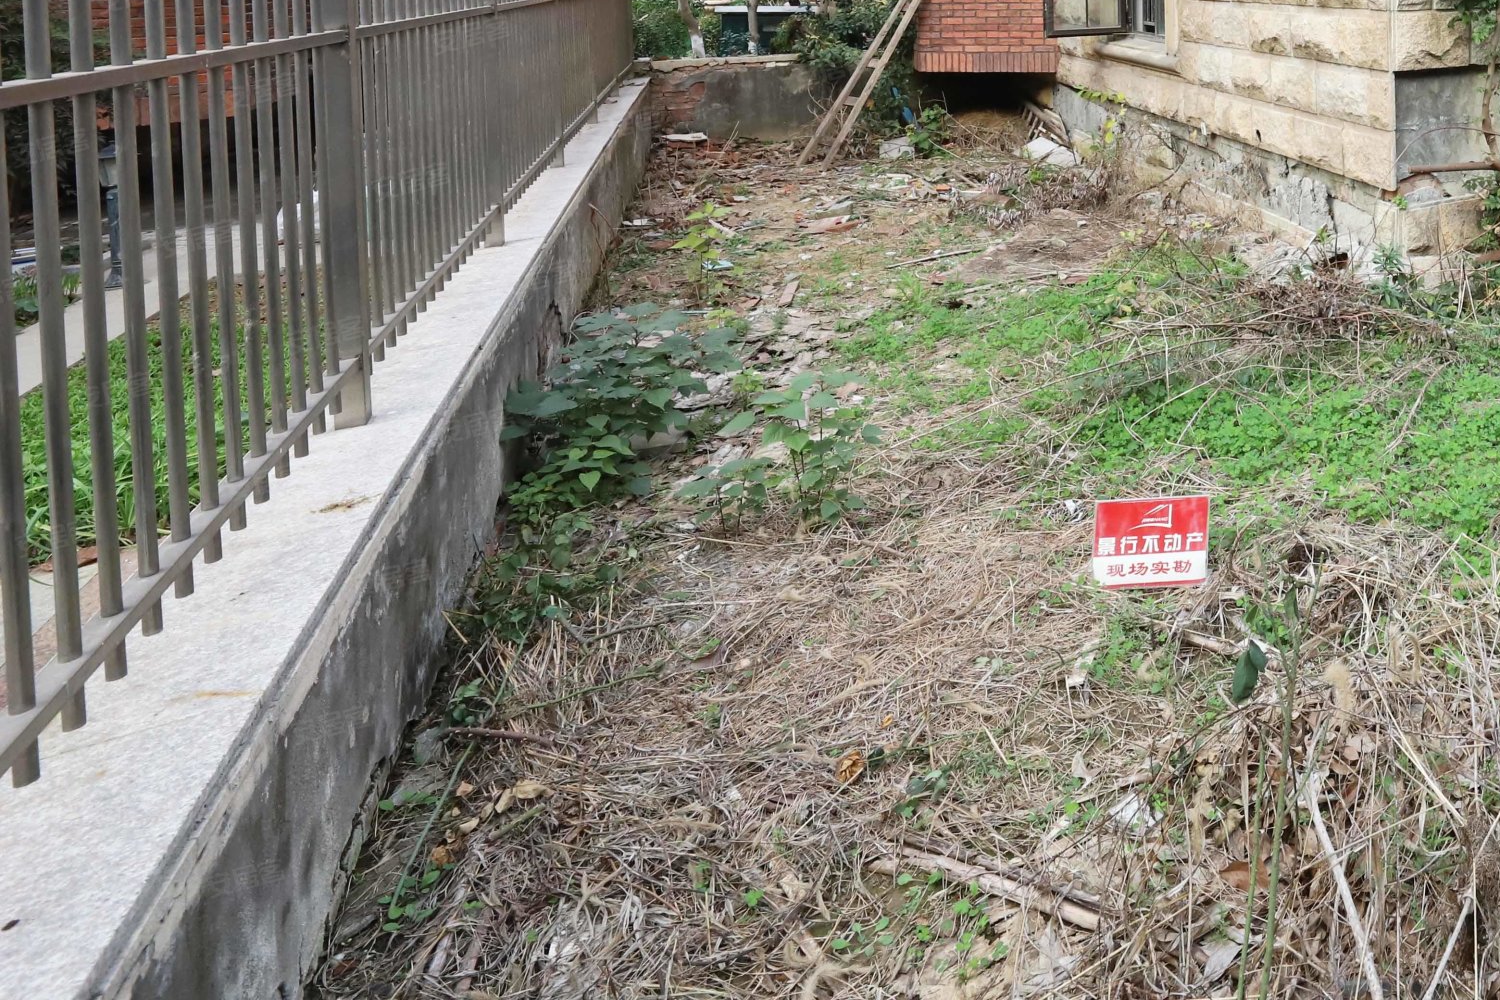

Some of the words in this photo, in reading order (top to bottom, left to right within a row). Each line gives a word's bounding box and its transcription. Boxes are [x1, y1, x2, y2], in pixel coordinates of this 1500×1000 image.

[1097, 533, 1203, 555] 景行不动产
[1106, 560, 1192, 577] 现场实勘
